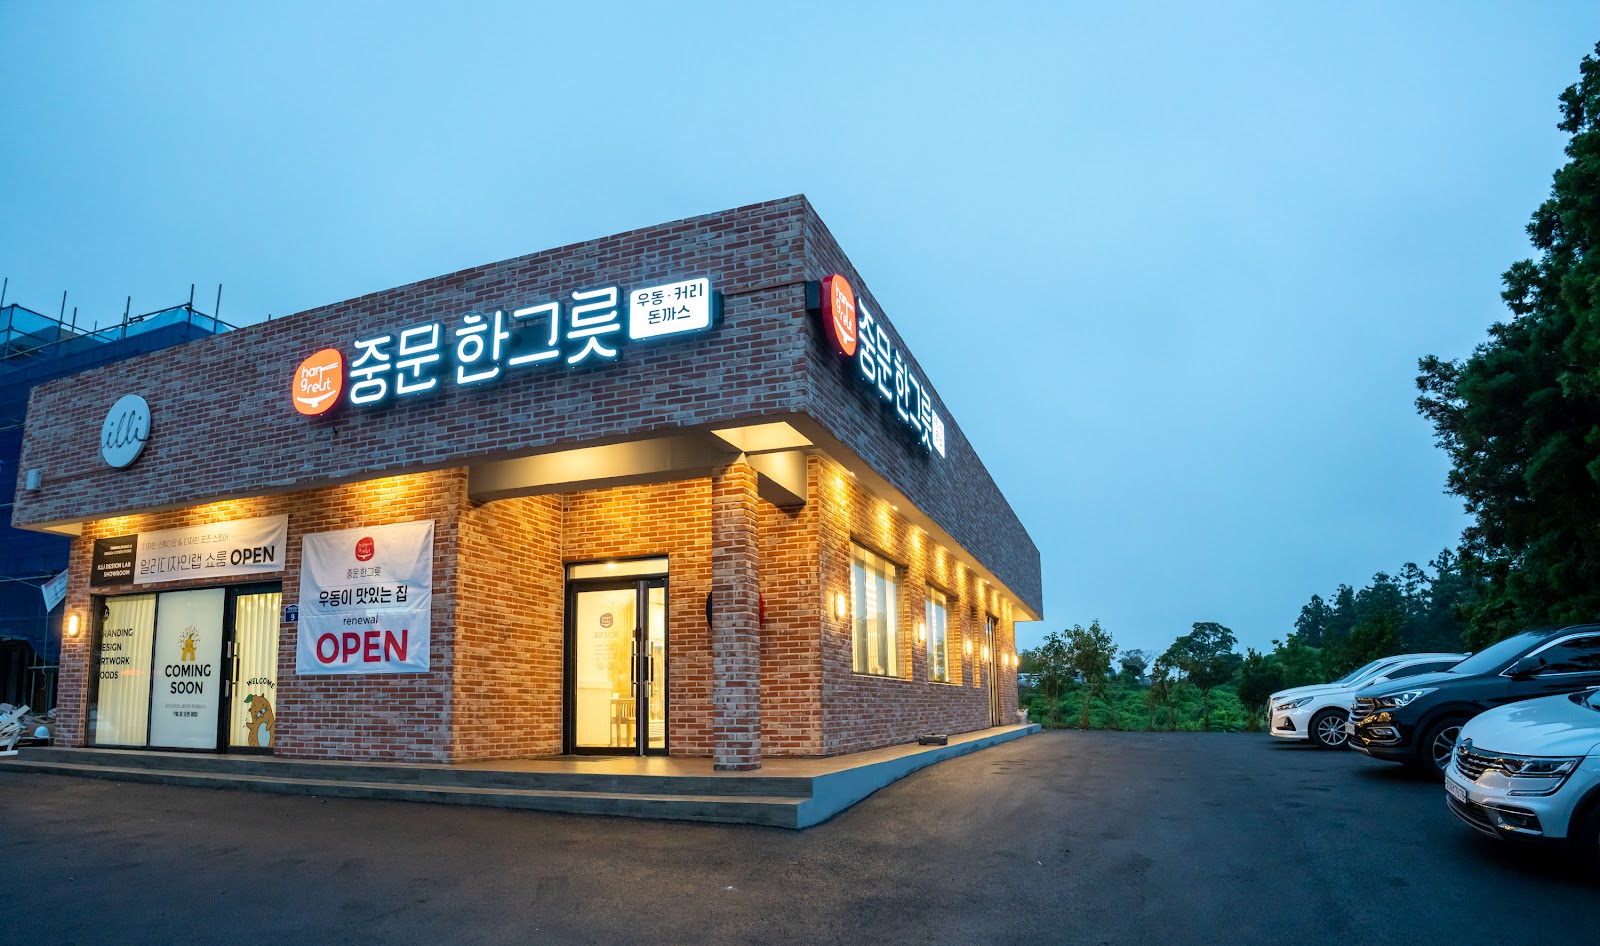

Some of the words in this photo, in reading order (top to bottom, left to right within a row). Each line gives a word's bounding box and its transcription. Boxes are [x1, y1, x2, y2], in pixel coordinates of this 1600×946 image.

[648, 305, 691, 325] 돈까스
[350, 323, 440, 404] 중문
[455, 286, 621, 385] 한그릇
[301, 365, 322, 379] han
[858, 297, 892, 401] 중문
[894, 349, 932, 450] 한그릇
[102, 409, 148, 449] illi
[184, 536, 200, 546] 디자인
[106, 562, 121, 570] DESIGN
[140, 552, 202, 575] 일리디자인랩
[204, 550, 227, 568] 쇼룸
[230, 545, 275, 566] OPEN
[347, 568, 359, 579] 중문
[360, 566, 381, 578] 한그릇
[319, 589, 352, 607] 우동이
[356, 586, 392, 605] 맛있는
[396, 585, 408, 602] 집
[290, 613, 295, 621] 9
[343, 615, 379, 625] renewal
[103, 628, 133, 638] RANDING
[102, 643, 122, 652] ESIGN
[316, 629, 408, 664] OPEN
[100, 671, 119, 680] OODS
[165, 664, 211, 678] COMING
[170, 681, 204, 695] SOON
[246, 677, 275, 689] WELCOME
